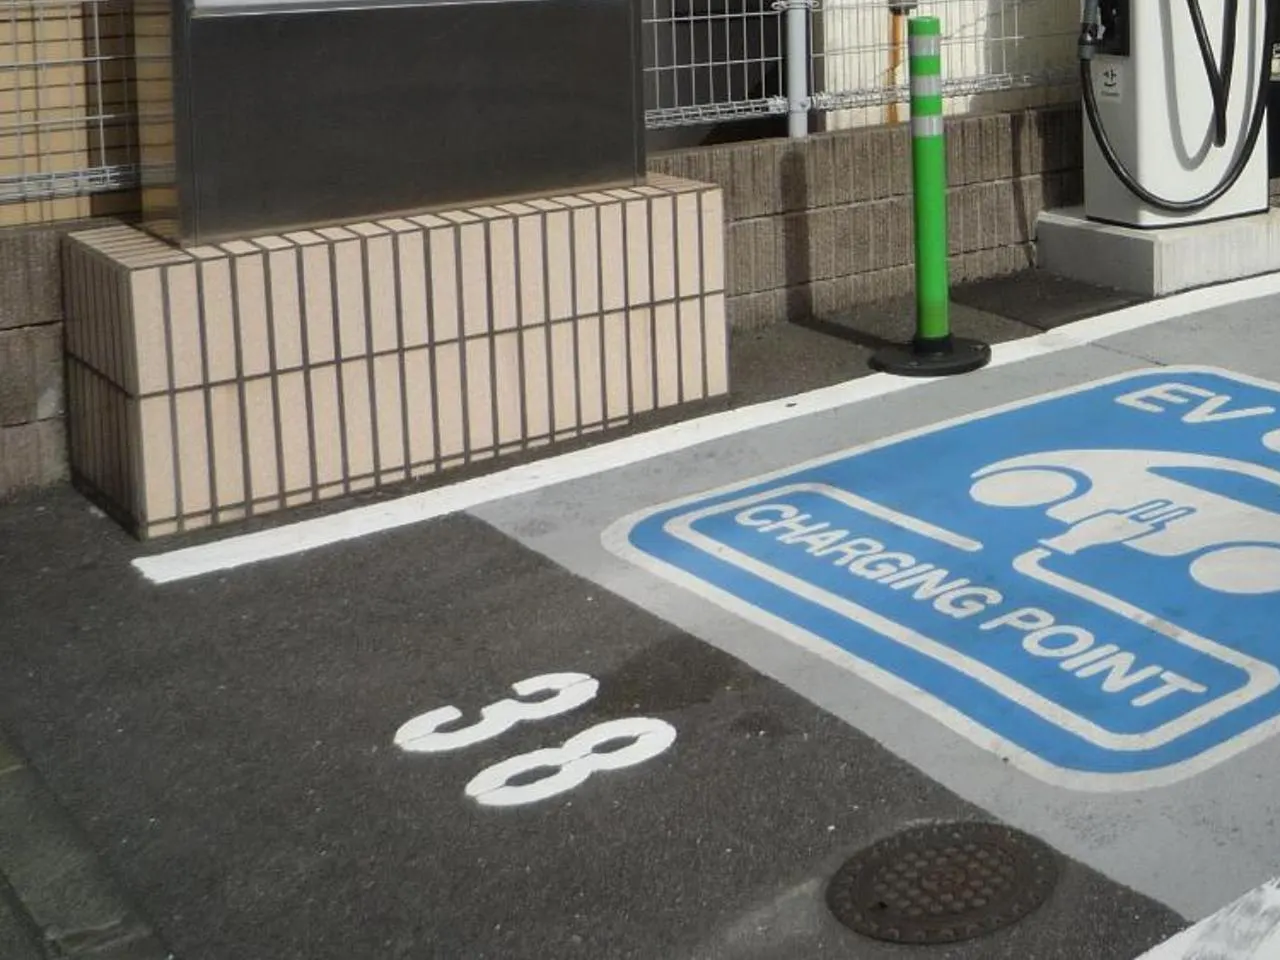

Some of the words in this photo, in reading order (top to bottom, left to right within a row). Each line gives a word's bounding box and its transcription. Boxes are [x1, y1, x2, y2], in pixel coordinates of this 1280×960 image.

[1113, 382, 1276, 424] EV
[735, 503, 1003, 620] CHARGING
[978, 607, 1208, 707] POINT
[393, 671, 677, 807] 38
